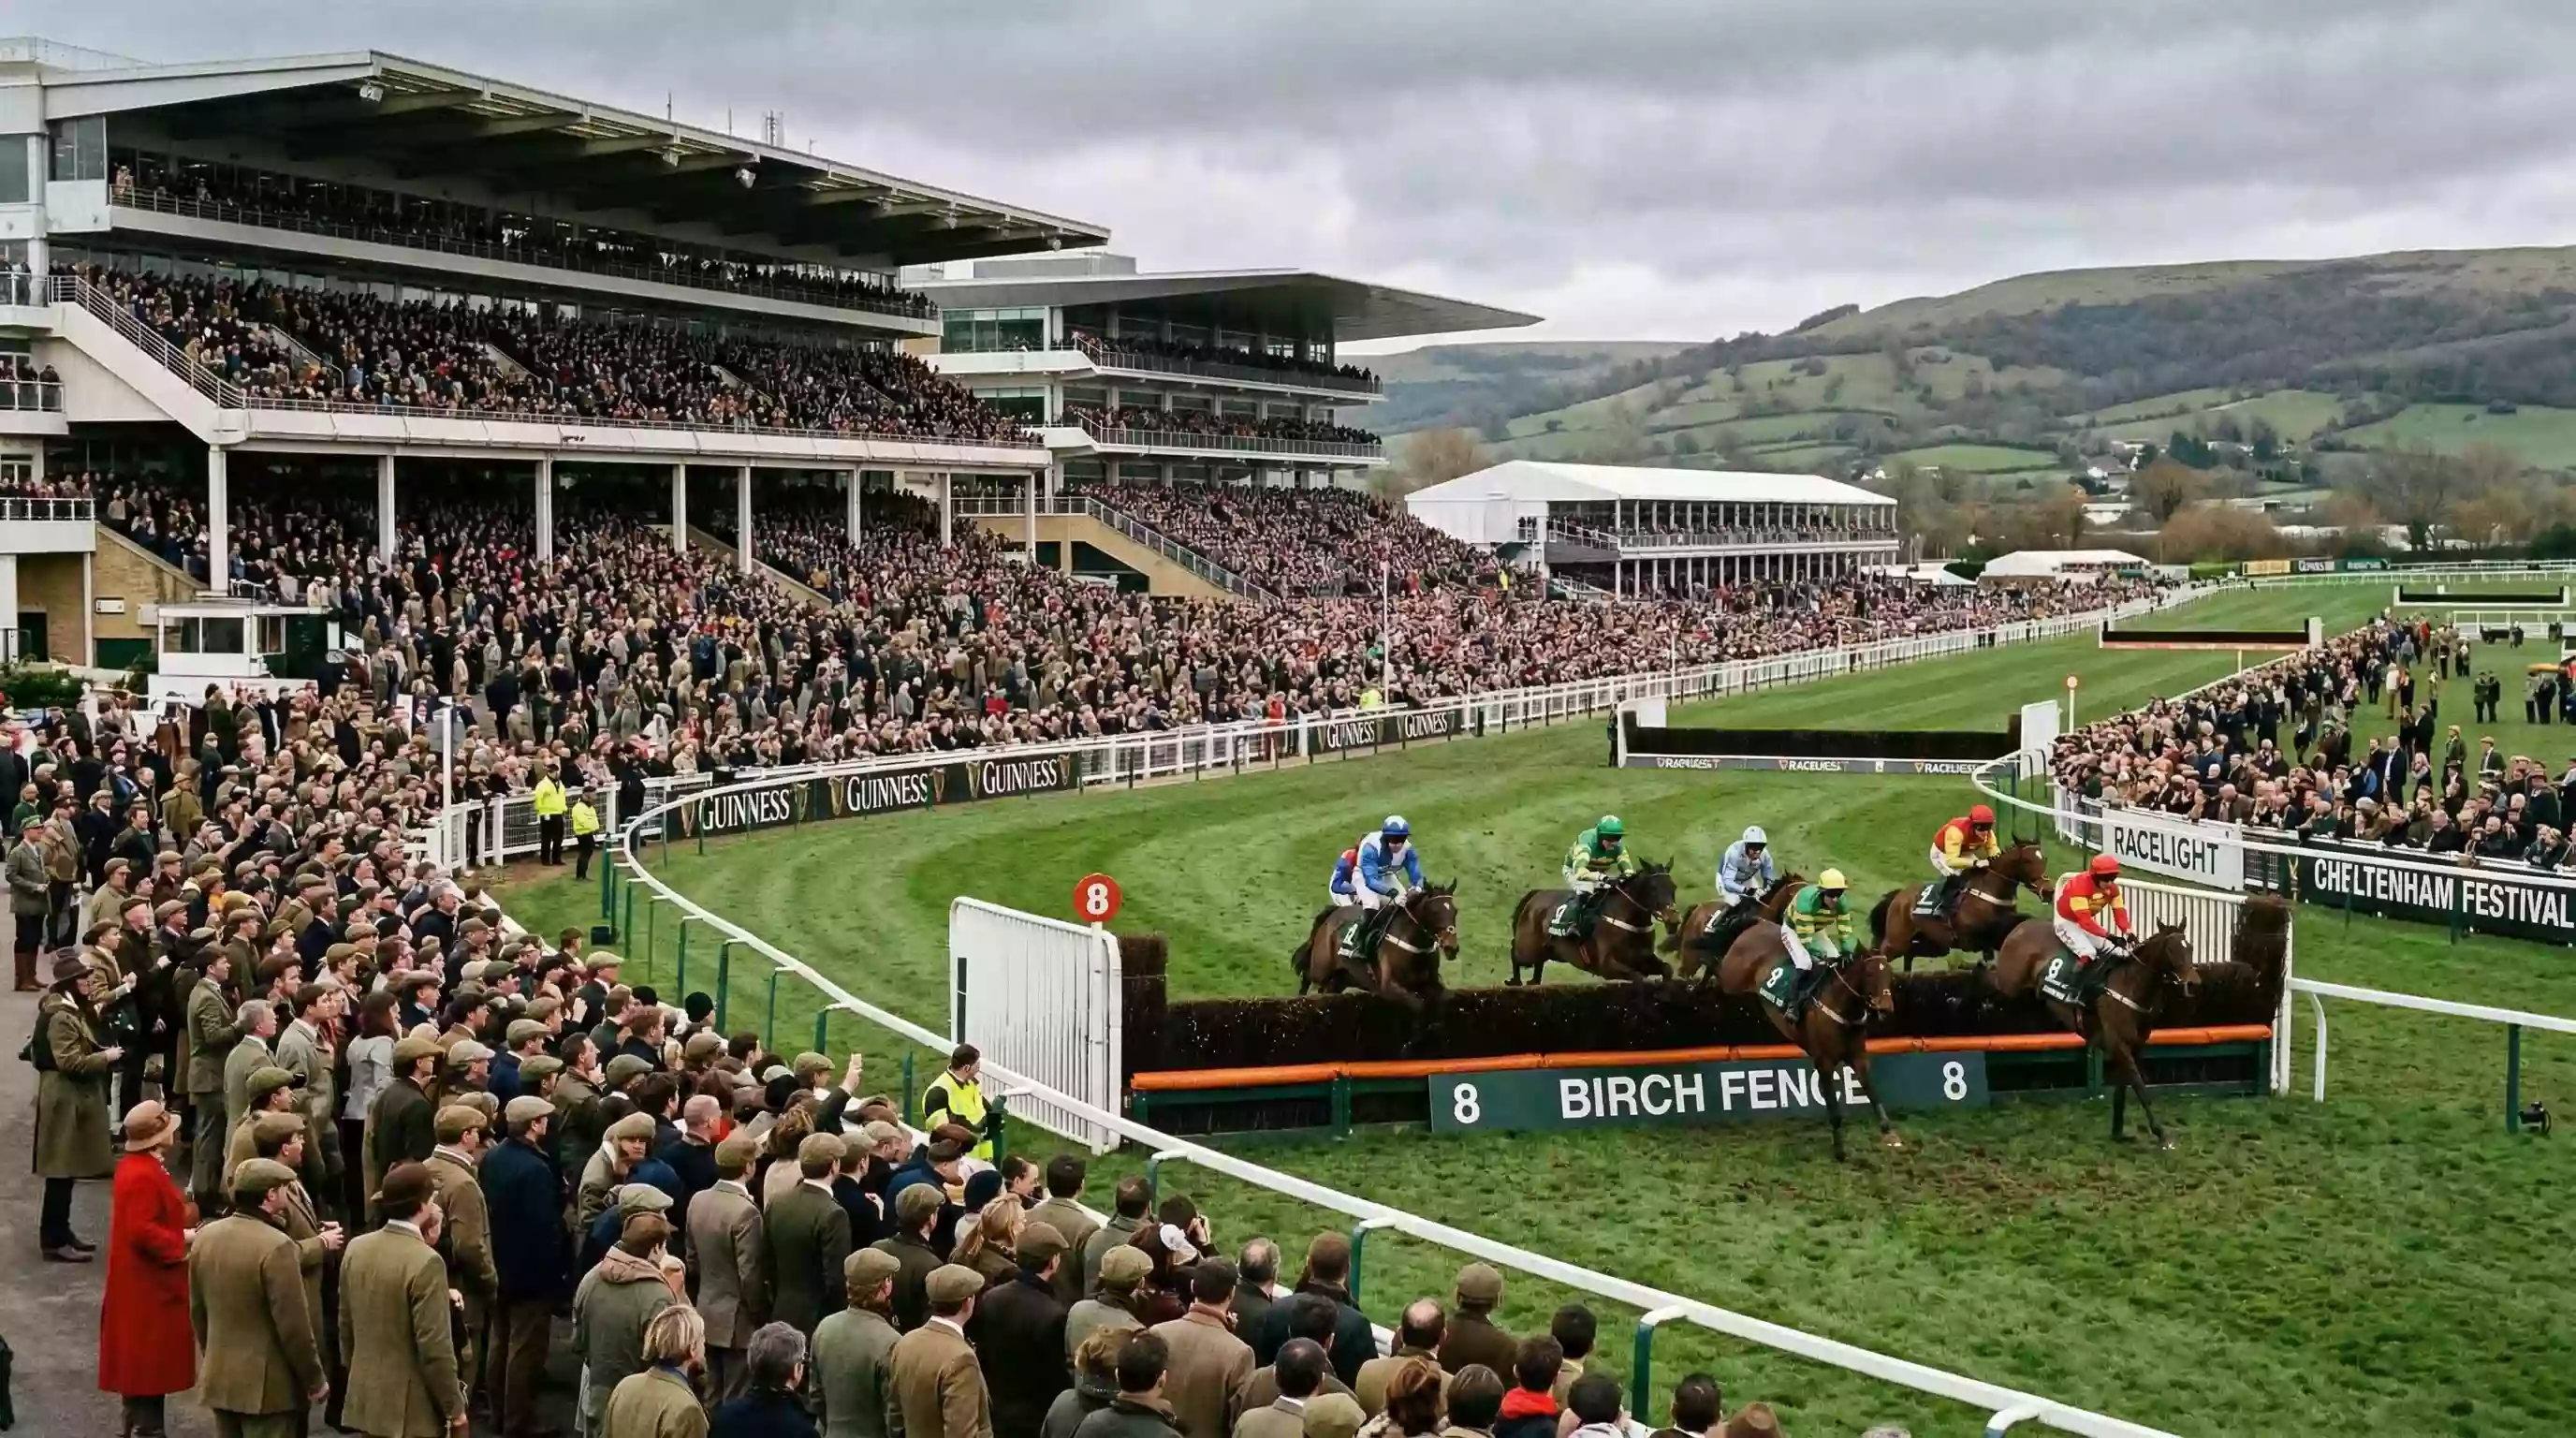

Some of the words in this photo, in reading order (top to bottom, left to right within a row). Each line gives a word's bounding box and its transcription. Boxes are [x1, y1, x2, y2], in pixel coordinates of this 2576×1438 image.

[847, 773, 929, 812] GUINNESS
[983, 758, 1058, 794] GUINNESS
[698, 789, 790, 830] GUINNESS
[2114, 826, 2219, 875] RACELIGHT
[1086, 883, 1109, 916] 8
[2314, 858, 2454, 911] CHELTENHAM
[2462, 879, 2575, 929] FESTIVAL
[1766, 967, 1784, 989] 8
[1454, 1082, 1481, 1124] 8
[1559, 1073, 1705, 1120] BIRCH
[1720, 1065, 1871, 1111] FENCE
[1942, 1061, 1968, 1101] 8
